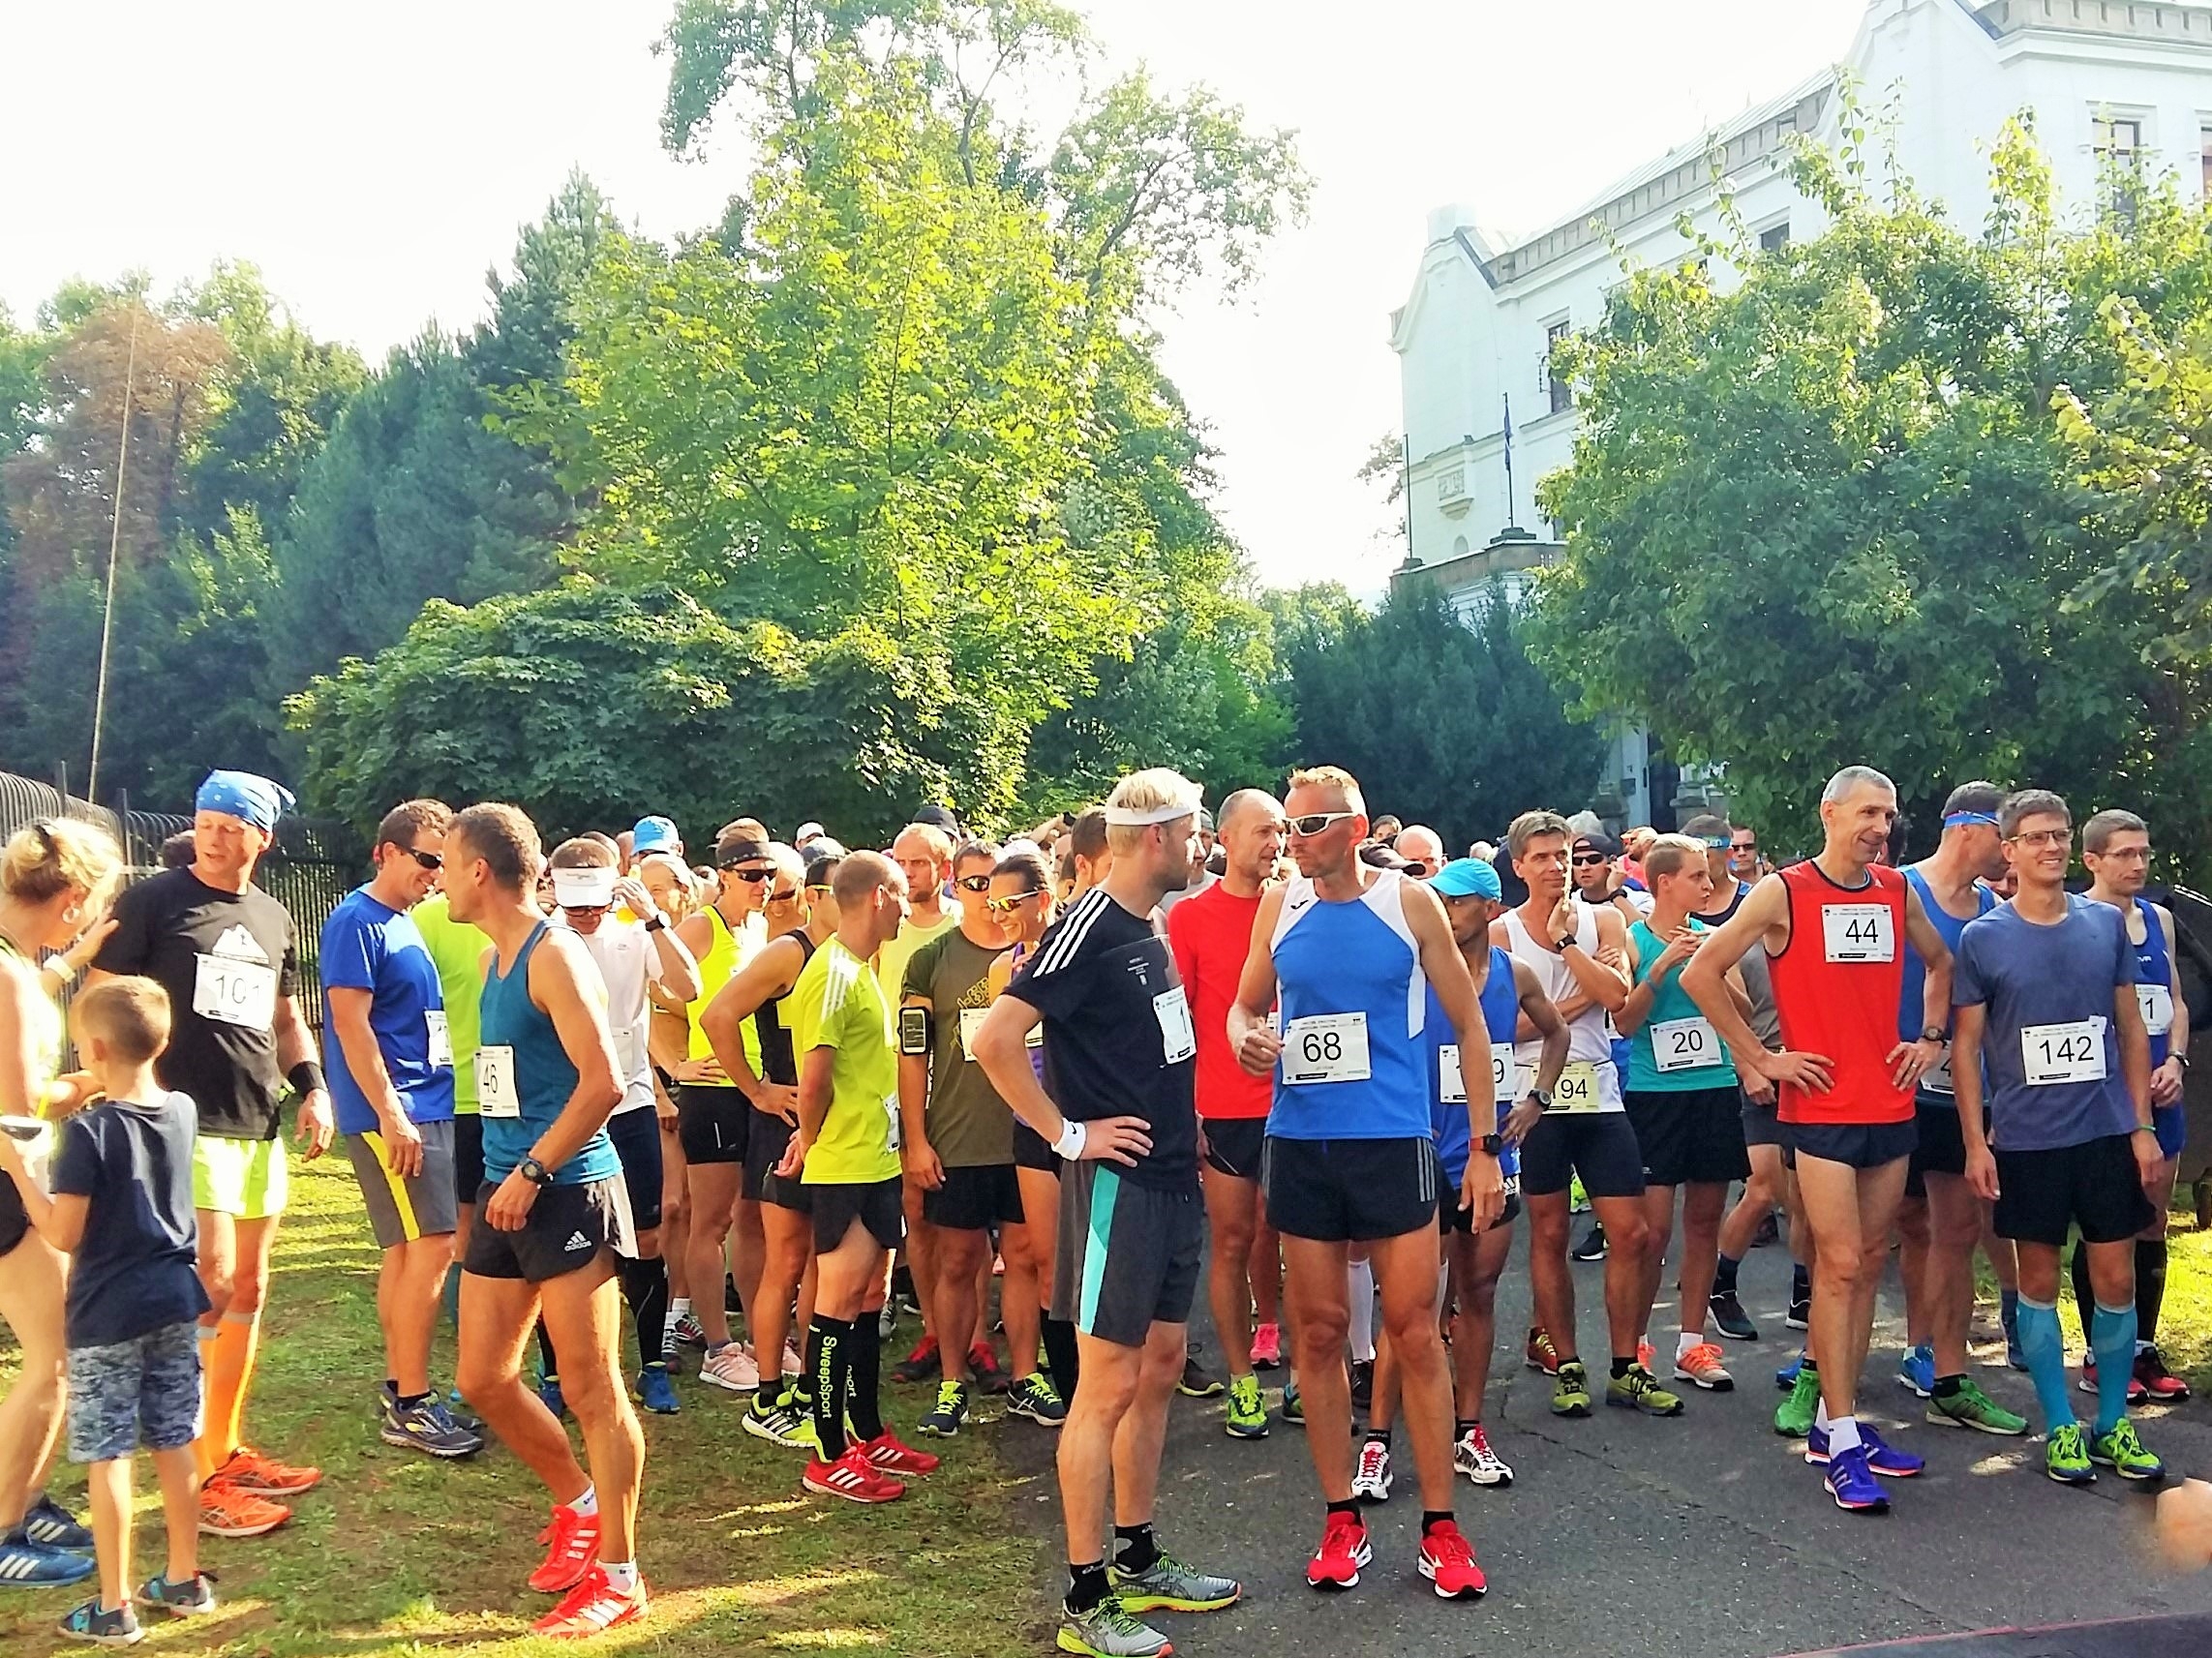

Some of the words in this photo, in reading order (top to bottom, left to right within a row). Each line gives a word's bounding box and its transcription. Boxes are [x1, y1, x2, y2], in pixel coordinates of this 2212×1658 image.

[1845, 918, 1879, 944] 44
[1303, 1032, 1342, 1063] 68
[1672, 1029, 1703, 1054] 20
[2039, 1036, 2095, 1065] 142
[483, 1063, 499, 1094] 46
[564, 1240, 592, 1251] adidas
[817, 1336, 837, 1419] SweepSport
